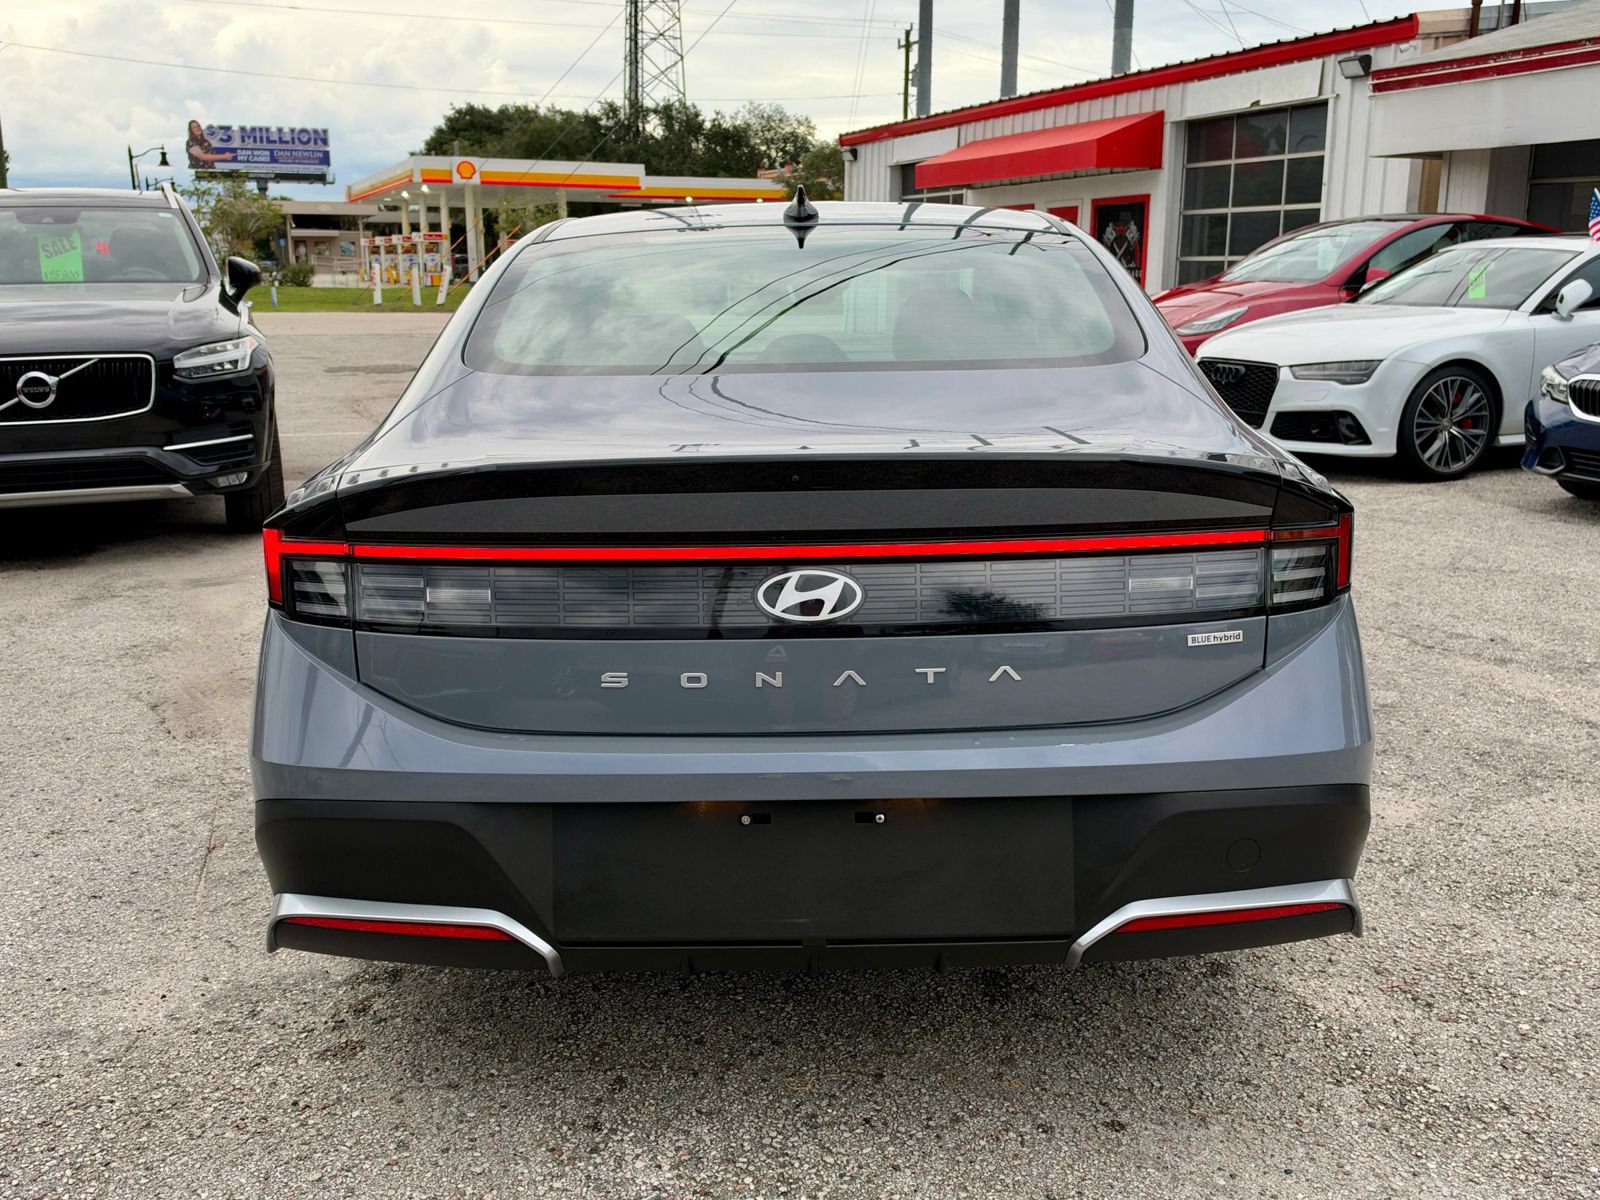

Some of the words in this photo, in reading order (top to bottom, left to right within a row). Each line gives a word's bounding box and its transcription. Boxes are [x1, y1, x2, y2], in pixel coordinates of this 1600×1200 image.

[206, 125, 233, 144] $3
[240, 127, 328, 146] MILLION
[41, 239, 78, 260] SALE
[1191, 635, 1212, 644] BLUE
[1213, 632, 1241, 643] hybrid
[600, 665, 1022, 688] SONATA
